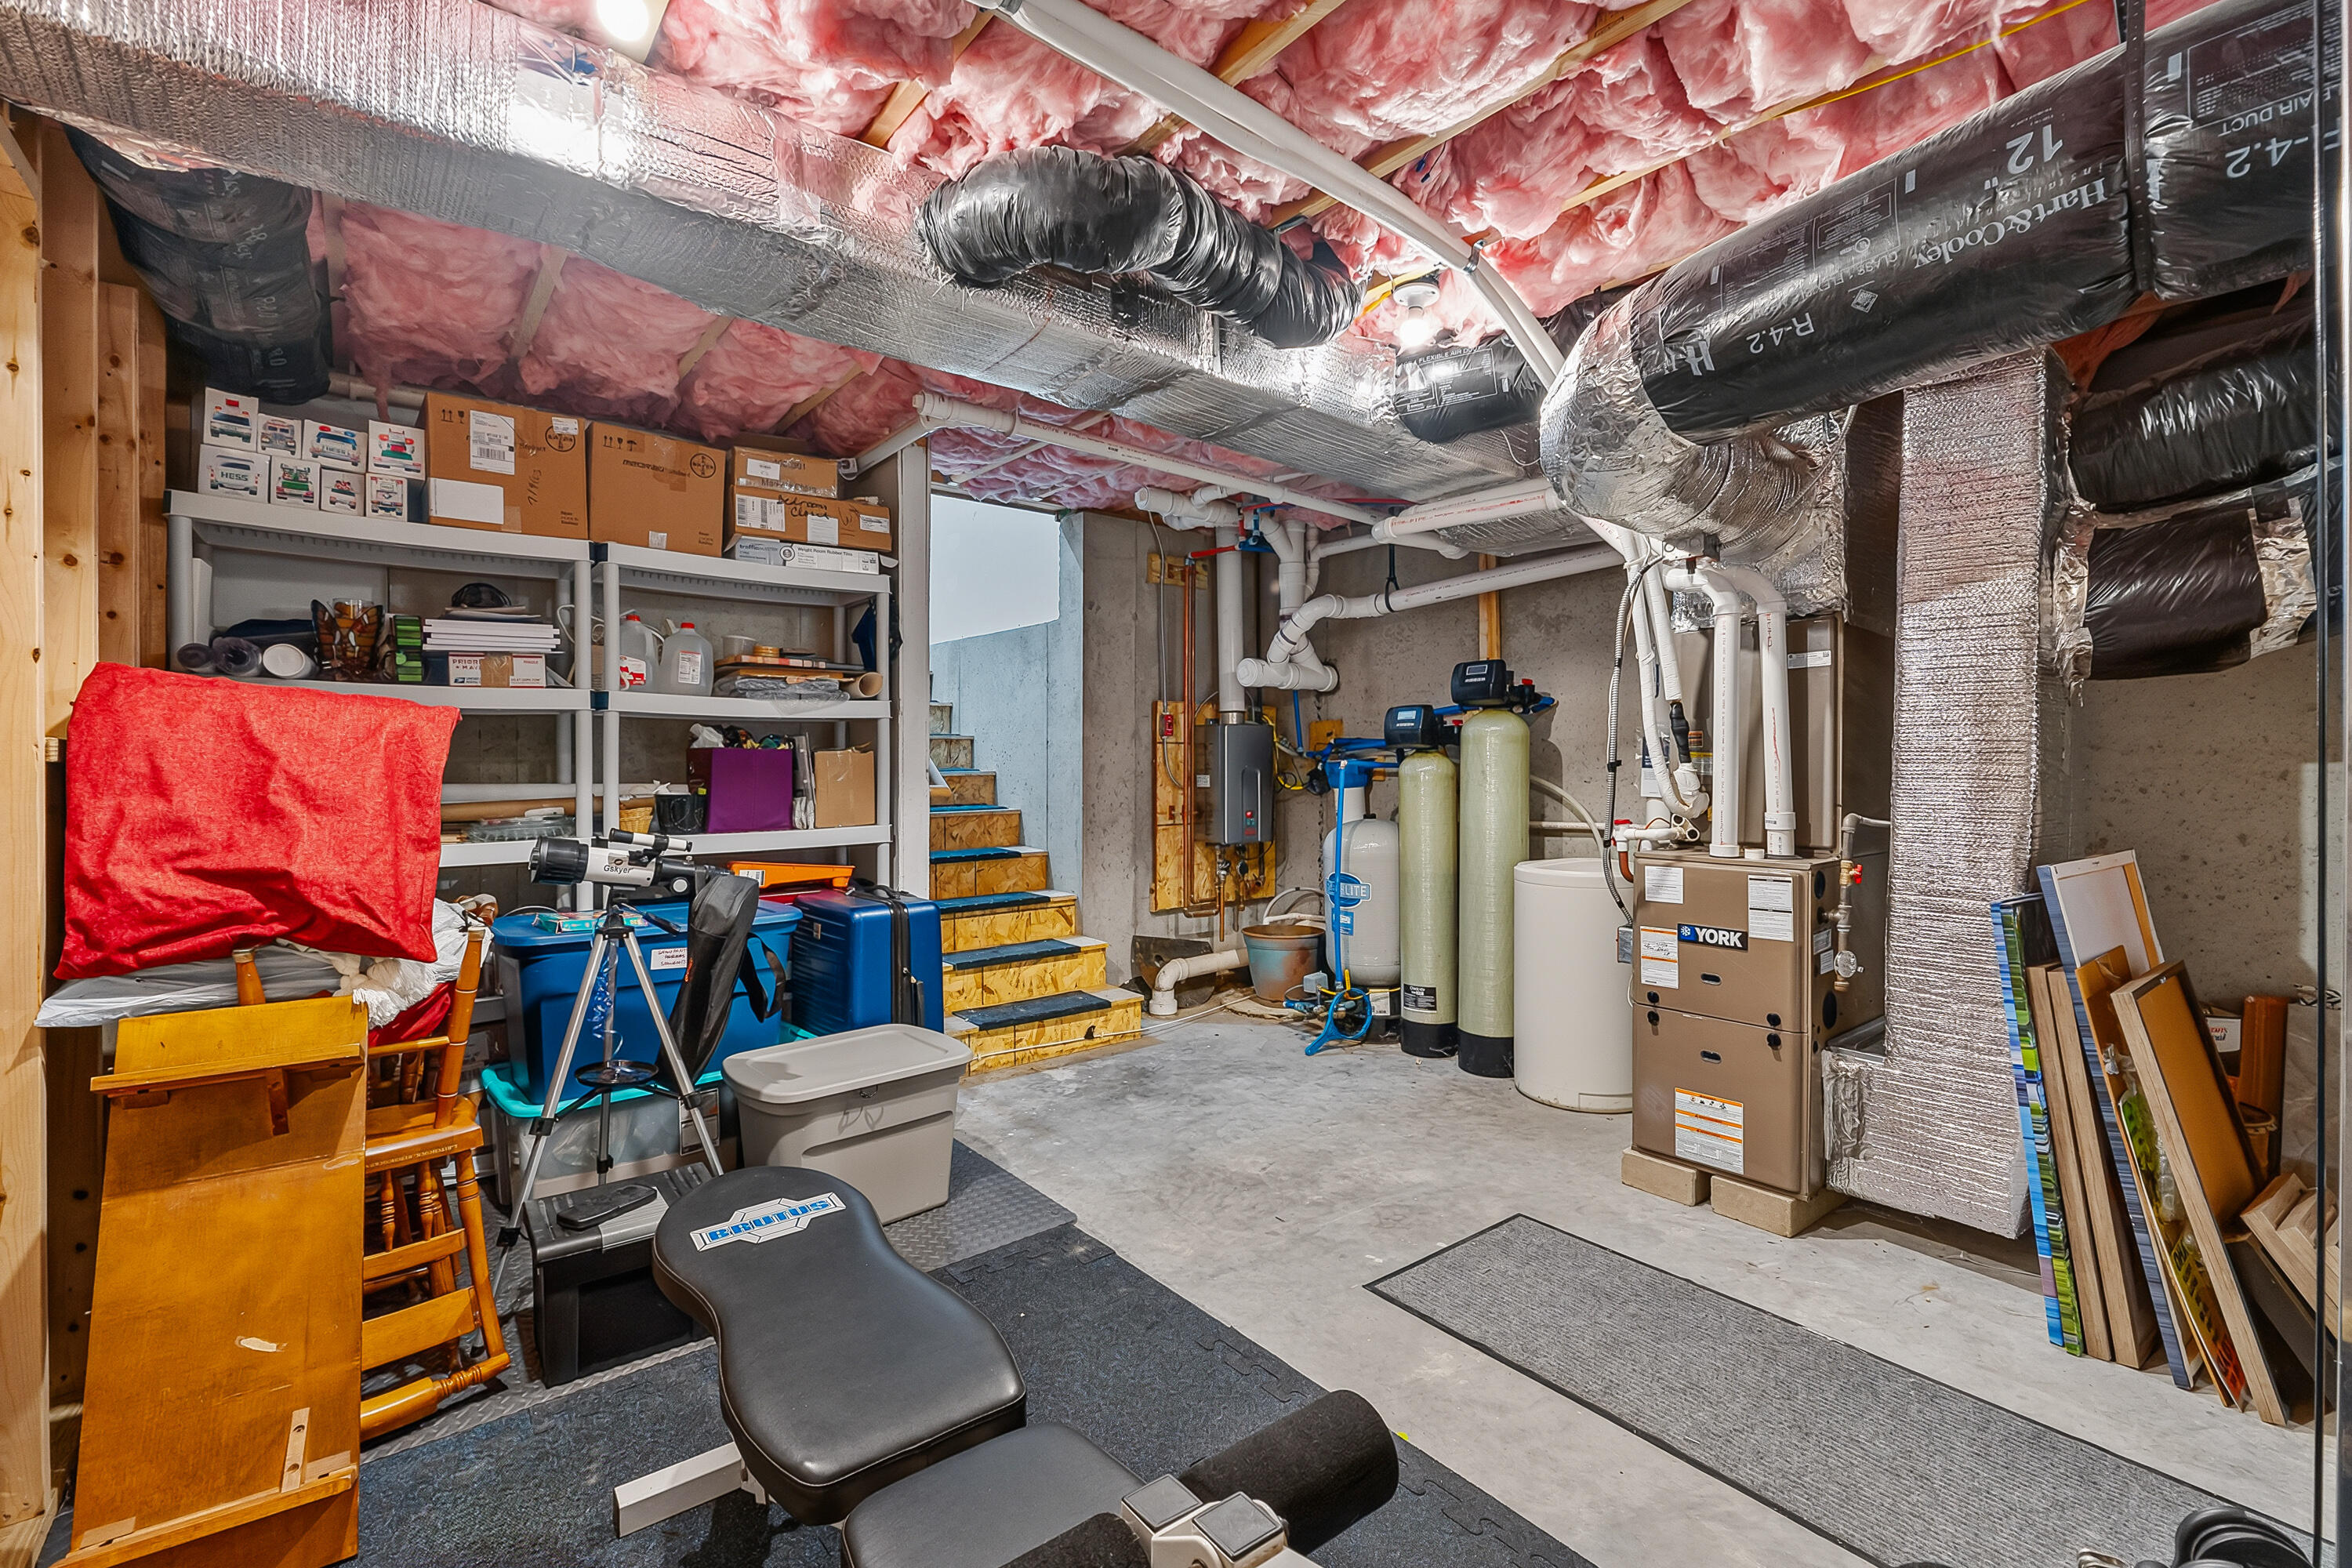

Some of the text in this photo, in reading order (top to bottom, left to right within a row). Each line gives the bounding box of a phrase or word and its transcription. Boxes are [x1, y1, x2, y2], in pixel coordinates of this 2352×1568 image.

[2216, 92, 2314, 138] AIR DUCT
[1857, 250, 1898, 276] CLASS
[1745, 311, 1815, 355] R-4.2
[1418, 351, 1449, 364] FLEXIBLE
[1450, 348, 1462, 358] AIR
[220, 470, 249, 482] HESS
[603, 864, 631, 875] Gskyer
[1693, 926, 1743, 948] YORK
[706, 1199, 832, 1243] BRUTUS
